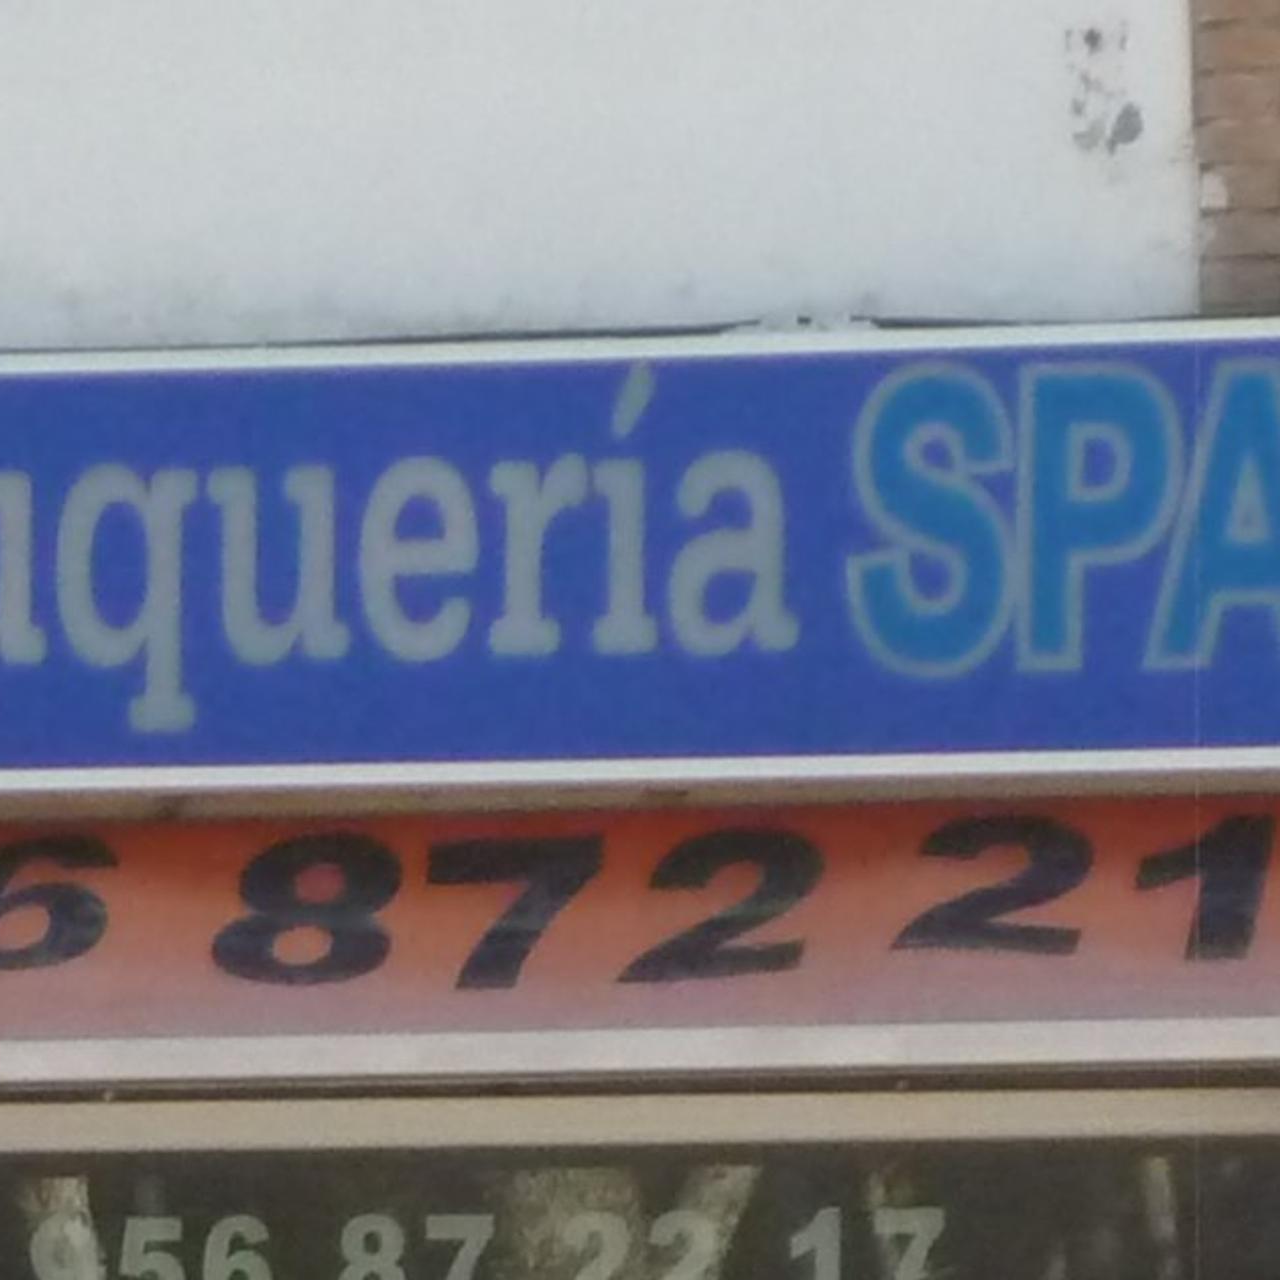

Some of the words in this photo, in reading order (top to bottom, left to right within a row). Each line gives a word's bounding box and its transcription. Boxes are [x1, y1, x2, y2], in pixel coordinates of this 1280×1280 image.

[845, 356, 1280, 680] SPA
[210, 826, 825, 989] 872
[889, 811, 1275, 963] 21
